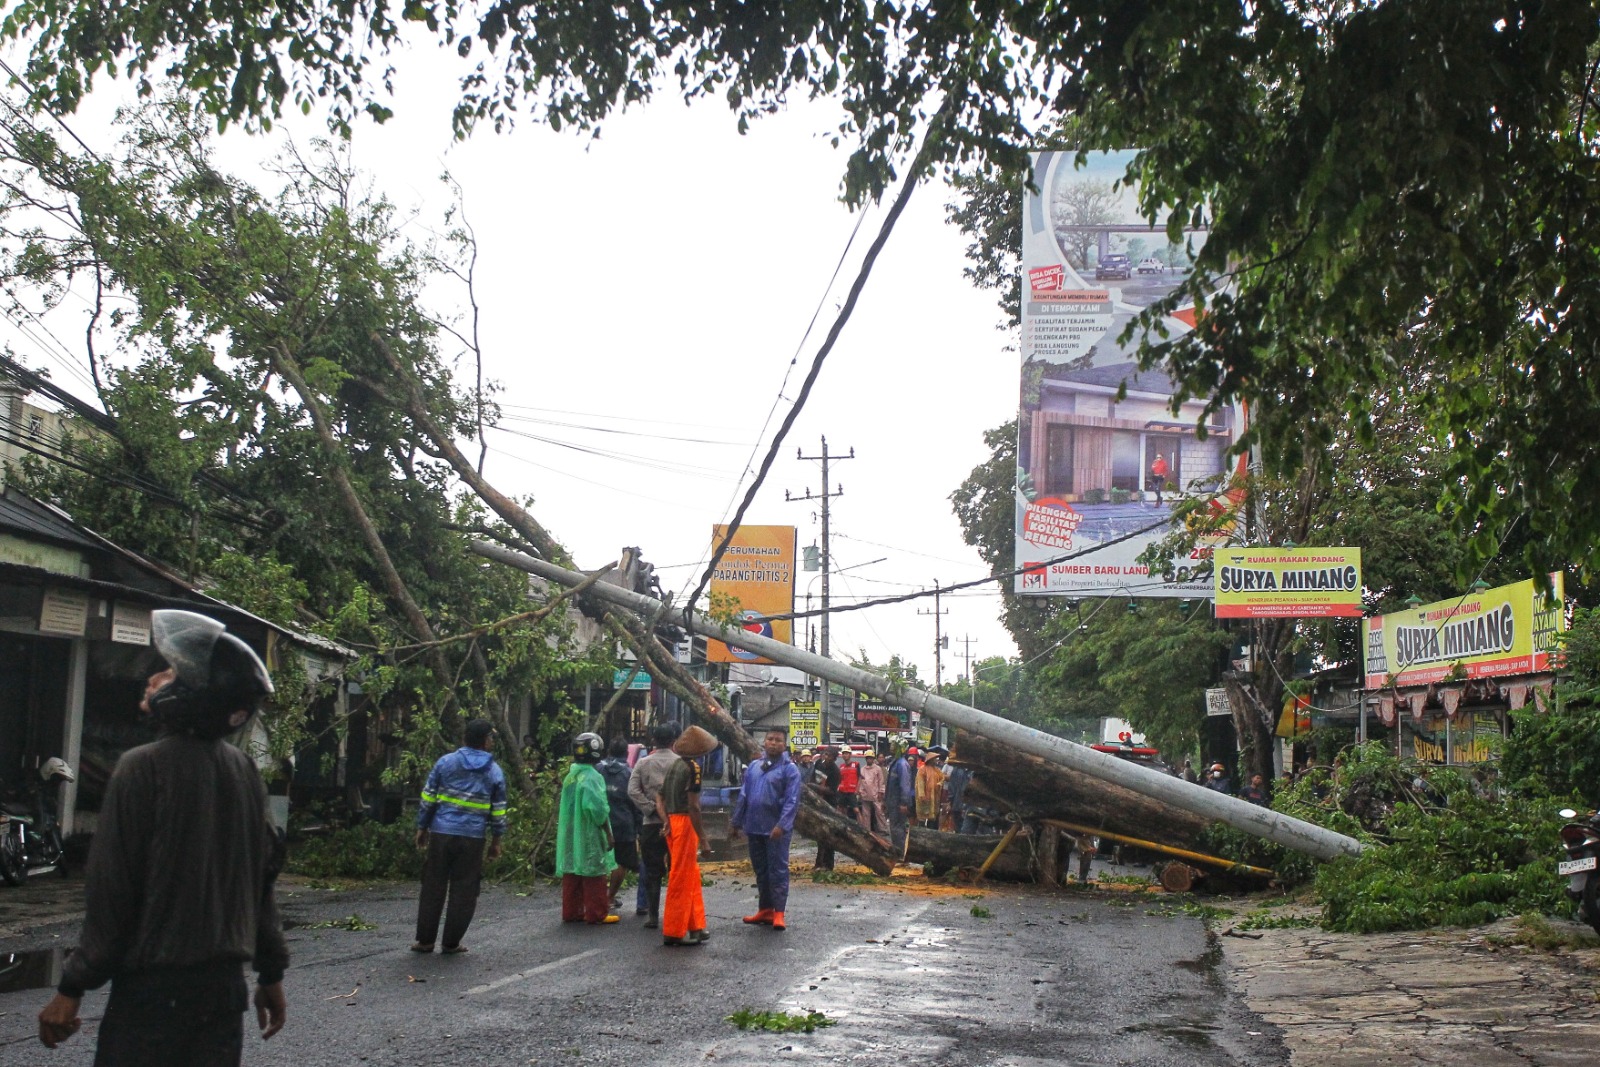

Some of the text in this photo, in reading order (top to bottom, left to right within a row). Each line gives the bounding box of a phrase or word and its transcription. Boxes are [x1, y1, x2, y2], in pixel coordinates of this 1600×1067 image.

[1041, 304, 1100, 313] DI TEMPAT KAMI
[1026, 503, 1084, 523] DILENGKAPI
[1028, 512, 1077, 530] FASILITAS
[1029, 521, 1072, 539] KOLAM
[1024, 530, 1073, 550] RENANG
[724, 546, 780, 555] PERUMAHAN
[713, 570, 789, 582] PARANGTRITIS 2
[1052, 566, 1149, 575] SUMBER BARU LAND
[1220, 565, 1357, 591] SURYA MINANG
[1460, 601, 1481, 614] PADANG
[1534, 608, 1556, 632] AYAM
[1396, 603, 1514, 663] SURYA MINANG
[1414, 735, 1444, 762] SURYA
